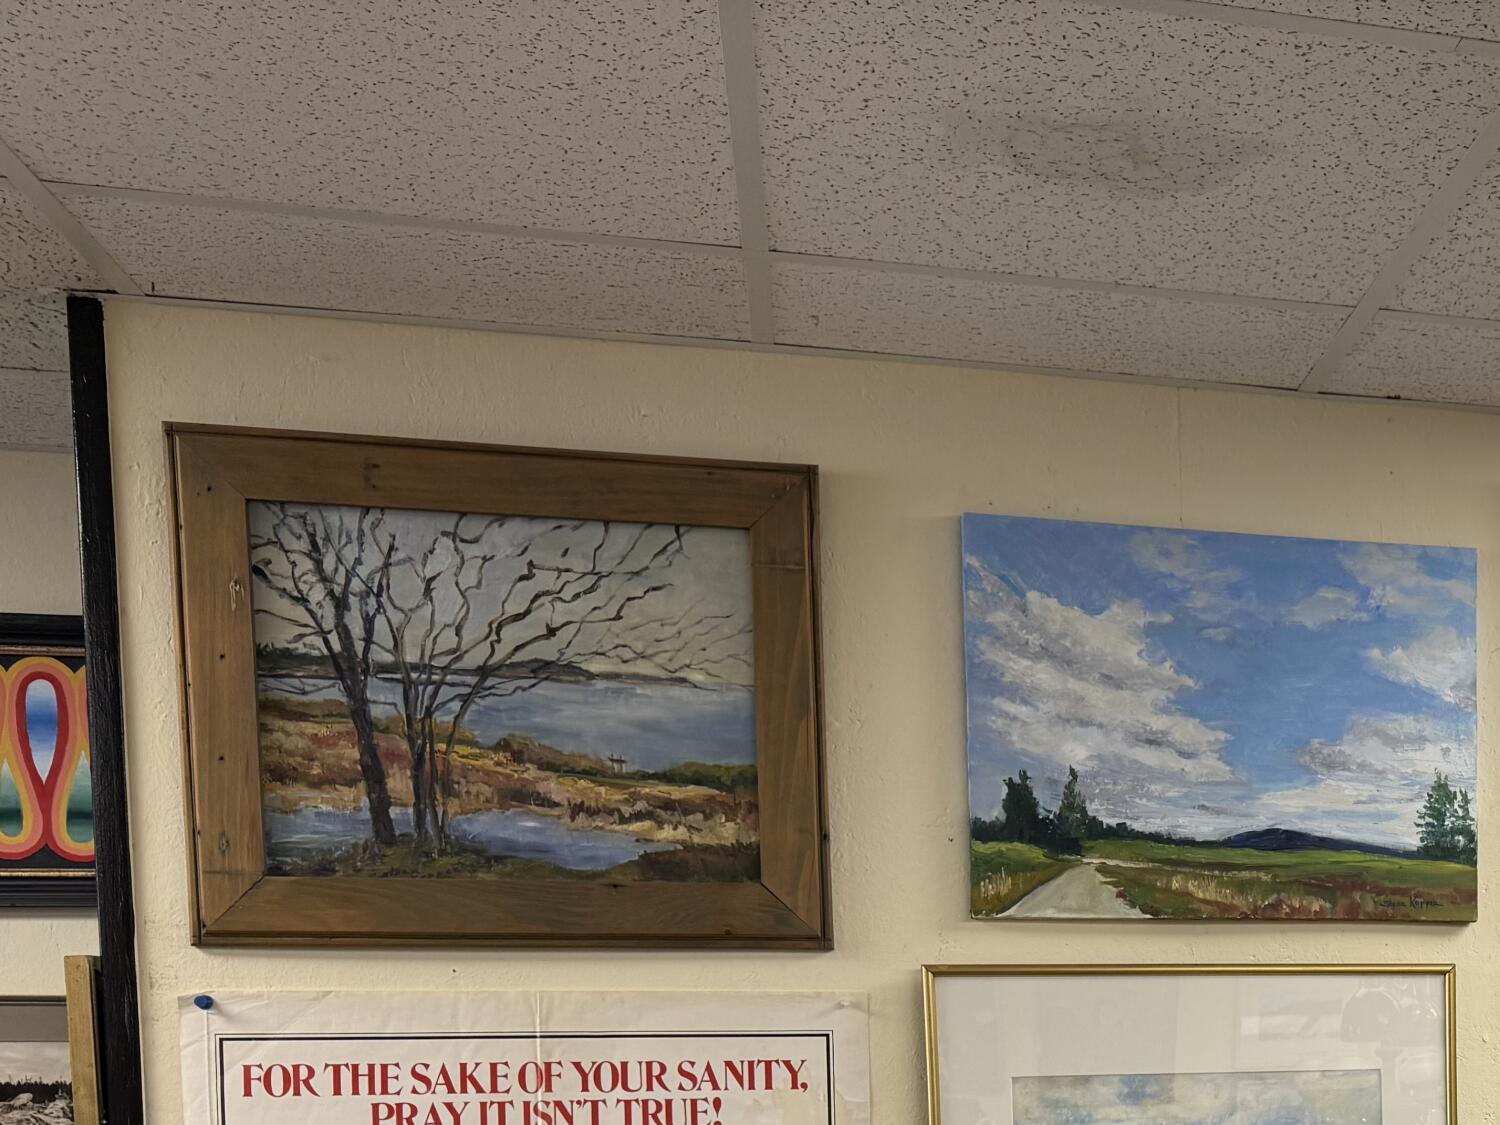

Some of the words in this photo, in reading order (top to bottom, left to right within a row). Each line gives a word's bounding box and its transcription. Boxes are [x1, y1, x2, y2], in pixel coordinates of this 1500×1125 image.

[242, 1063, 321, 1098] FOR
[324, 1062, 402, 1096] THE
[411, 1061, 512, 1096] SAKE
[518, 1061, 563, 1095] OF
[573, 1060, 681, 1093] YOUR
[677, 1059, 809, 1096] SANITY,
